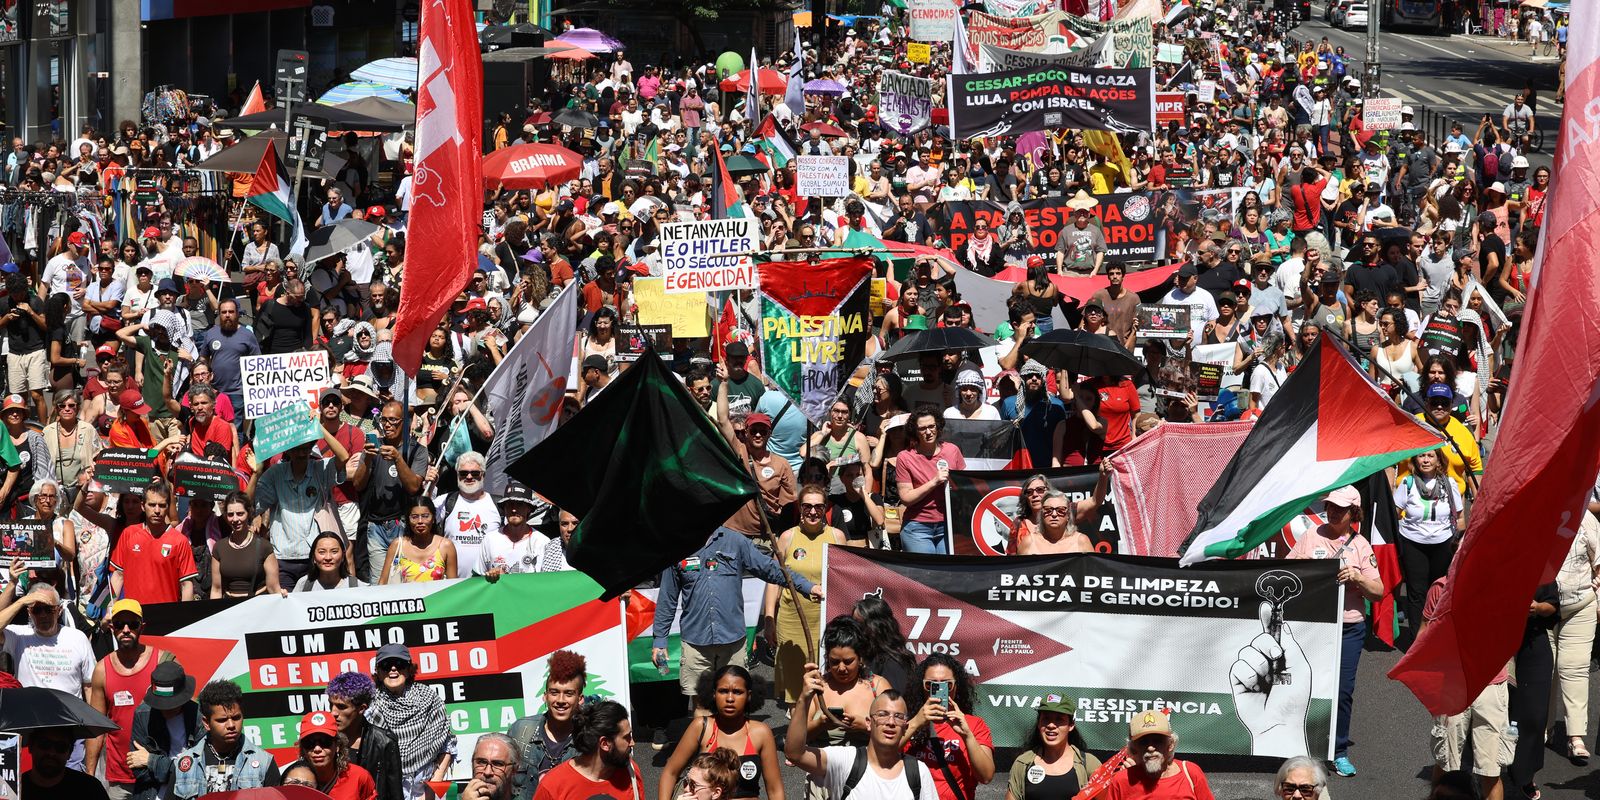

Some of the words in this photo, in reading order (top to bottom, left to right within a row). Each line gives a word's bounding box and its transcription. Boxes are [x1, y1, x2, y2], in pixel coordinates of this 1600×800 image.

[966, 70, 1068, 92] CESSAR-FOGO
[1070, 72, 1092, 84] EM
[1095, 74, 1136, 86] GAZA
[966, 94, 1006, 106] LULA,
[1010, 86, 1060, 101] ROMPA
[1064, 84, 1136, 103] RELAÇÕES
[1012, 100, 1046, 113] COM
[1048, 98, 1094, 111] ISRAEL
[510, 154, 566, 174] BRAHMA
[799, 172, 834, 180] PALESTINA
[800, 180, 821, 188] GLOBAL
[822, 180, 847, 188] SUMUD
[804, 187, 844, 196] FLOTILLA!
[950, 212, 967, 230] A
[974, 203, 1122, 229] PAESTNA
[663, 221, 748, 240] NETANYAHU
[1032, 224, 1154, 249] SORRO!
[665, 240, 676, 257] É
[678, 243, 688, 256] O
[692, 238, 751, 255] HITLER
[667, 258, 685, 270] DO
[688, 254, 738, 269] SÉCULO
[666, 270, 676, 290] É
[677, 267, 753, 290] GENOCIDA!
[763, 312, 864, 340] PALESTINA
[244, 357, 286, 372] ISRAEL
[288, 352, 324, 368] MATA
[792, 340, 845, 364] LIVRE
[246, 366, 330, 386] CRIANÇAS!
[249, 386, 300, 400] ROMPER
[247, 400, 307, 416] RELA
[1000, 574, 1076, 588] BASTA
[1084, 576, 1112, 590] DE
[1120, 577, 1219, 594] LIMPEZA
[988, 586, 1073, 603] ÉTNICA
[1080, 592, 1093, 603] E
[1100, 590, 1239, 609] GENOCÍDIO!
[308, 607, 324, 622] 76
[327, 604, 360, 621] ANOS
[362, 603, 380, 618] DE
[382, 599, 424, 616] NAKBA
[906, 607, 962, 640] 77
[281, 633, 326, 655] UM
[343, 626, 405, 650] ANO
[422, 622, 460, 644] DE
[906, 642, 960, 656] ANOS
[259, 647, 488, 686] GENODIO
[288, 694, 331, 714] UM
[434, 681, 466, 701] DE
[988, 695, 1042, 708] VIVA
[1078, 697, 1222, 715] RESISTÊNCIA
[244, 705, 517, 746] RESCIA
